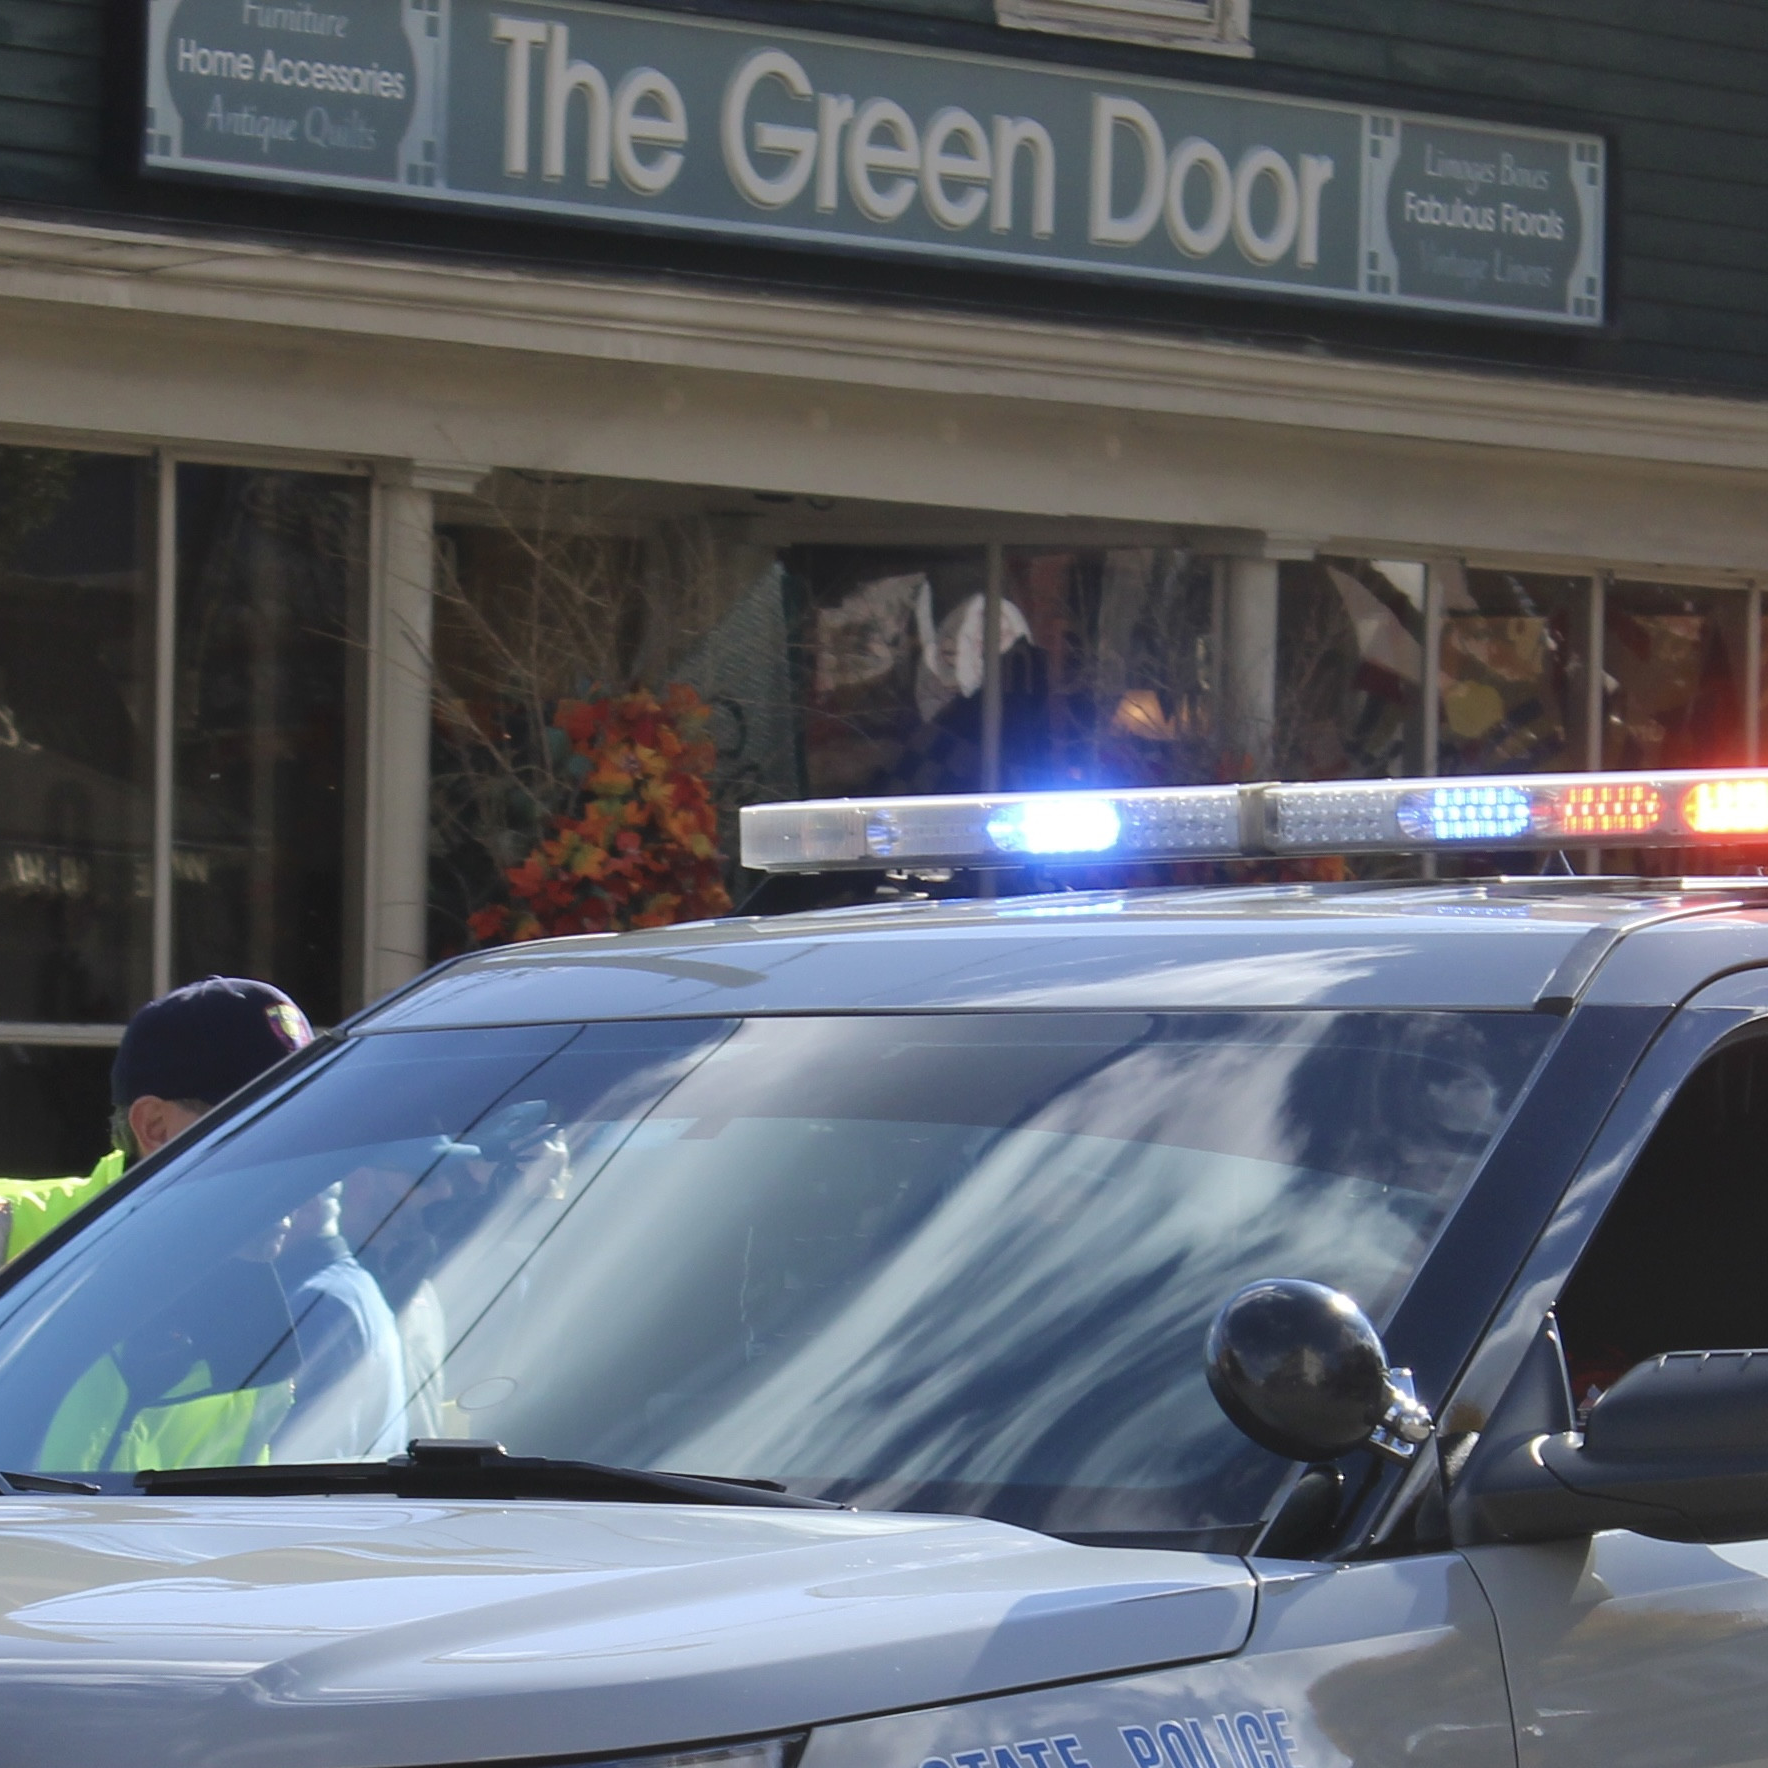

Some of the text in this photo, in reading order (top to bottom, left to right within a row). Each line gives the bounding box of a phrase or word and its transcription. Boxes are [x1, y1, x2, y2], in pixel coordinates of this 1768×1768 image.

[177, 37, 406, 100] Home Accessories
[205, 94, 298, 153] Antique
[491, 16, 1334, 267] The Green Door
[1403, 190, 1565, 241] Fabulous Florals
